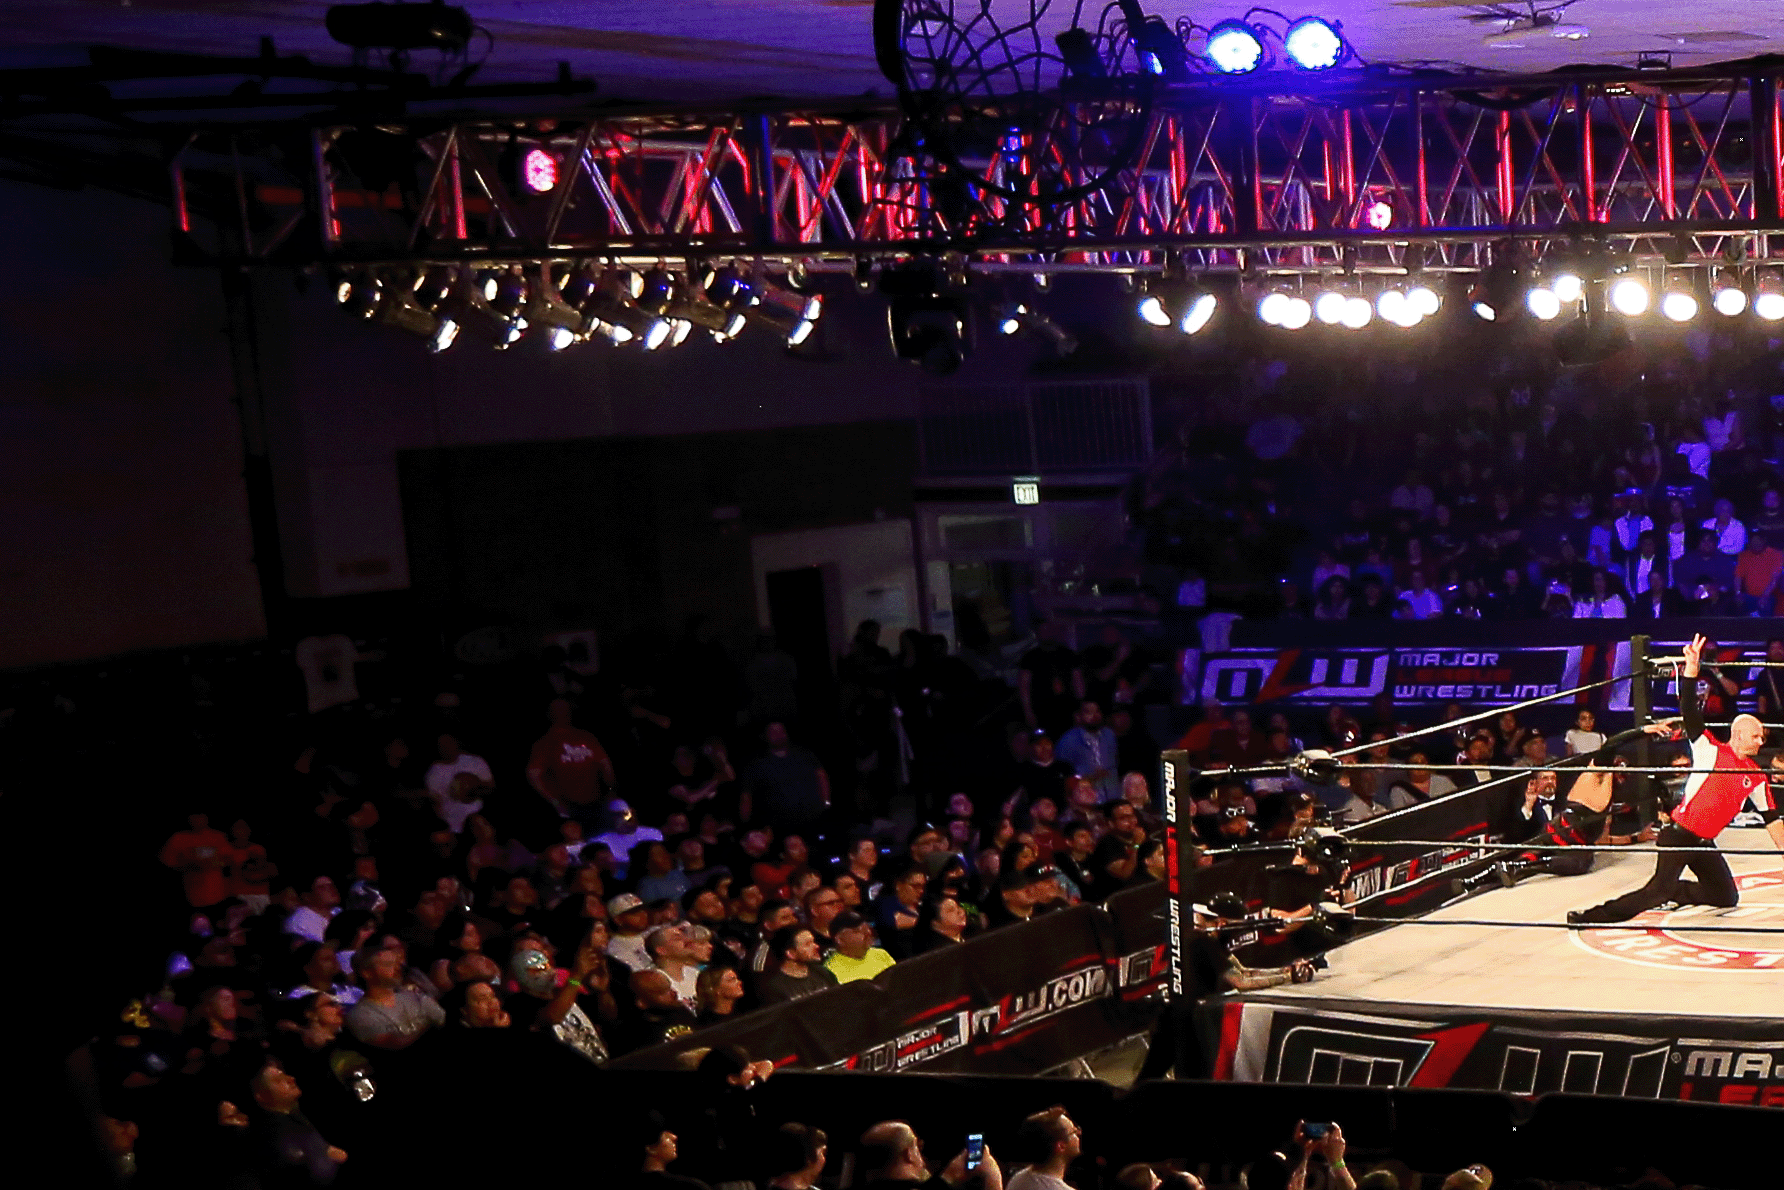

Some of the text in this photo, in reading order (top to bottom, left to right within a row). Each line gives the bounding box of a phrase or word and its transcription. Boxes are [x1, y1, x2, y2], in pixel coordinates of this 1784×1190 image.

[1398, 652, 1499, 666] MAJOR
[1393, 684, 1558, 699] WRESTLING
[1164, 761, 1176, 823] MAJOR
[1169, 898, 1183, 995] WRESTLING
